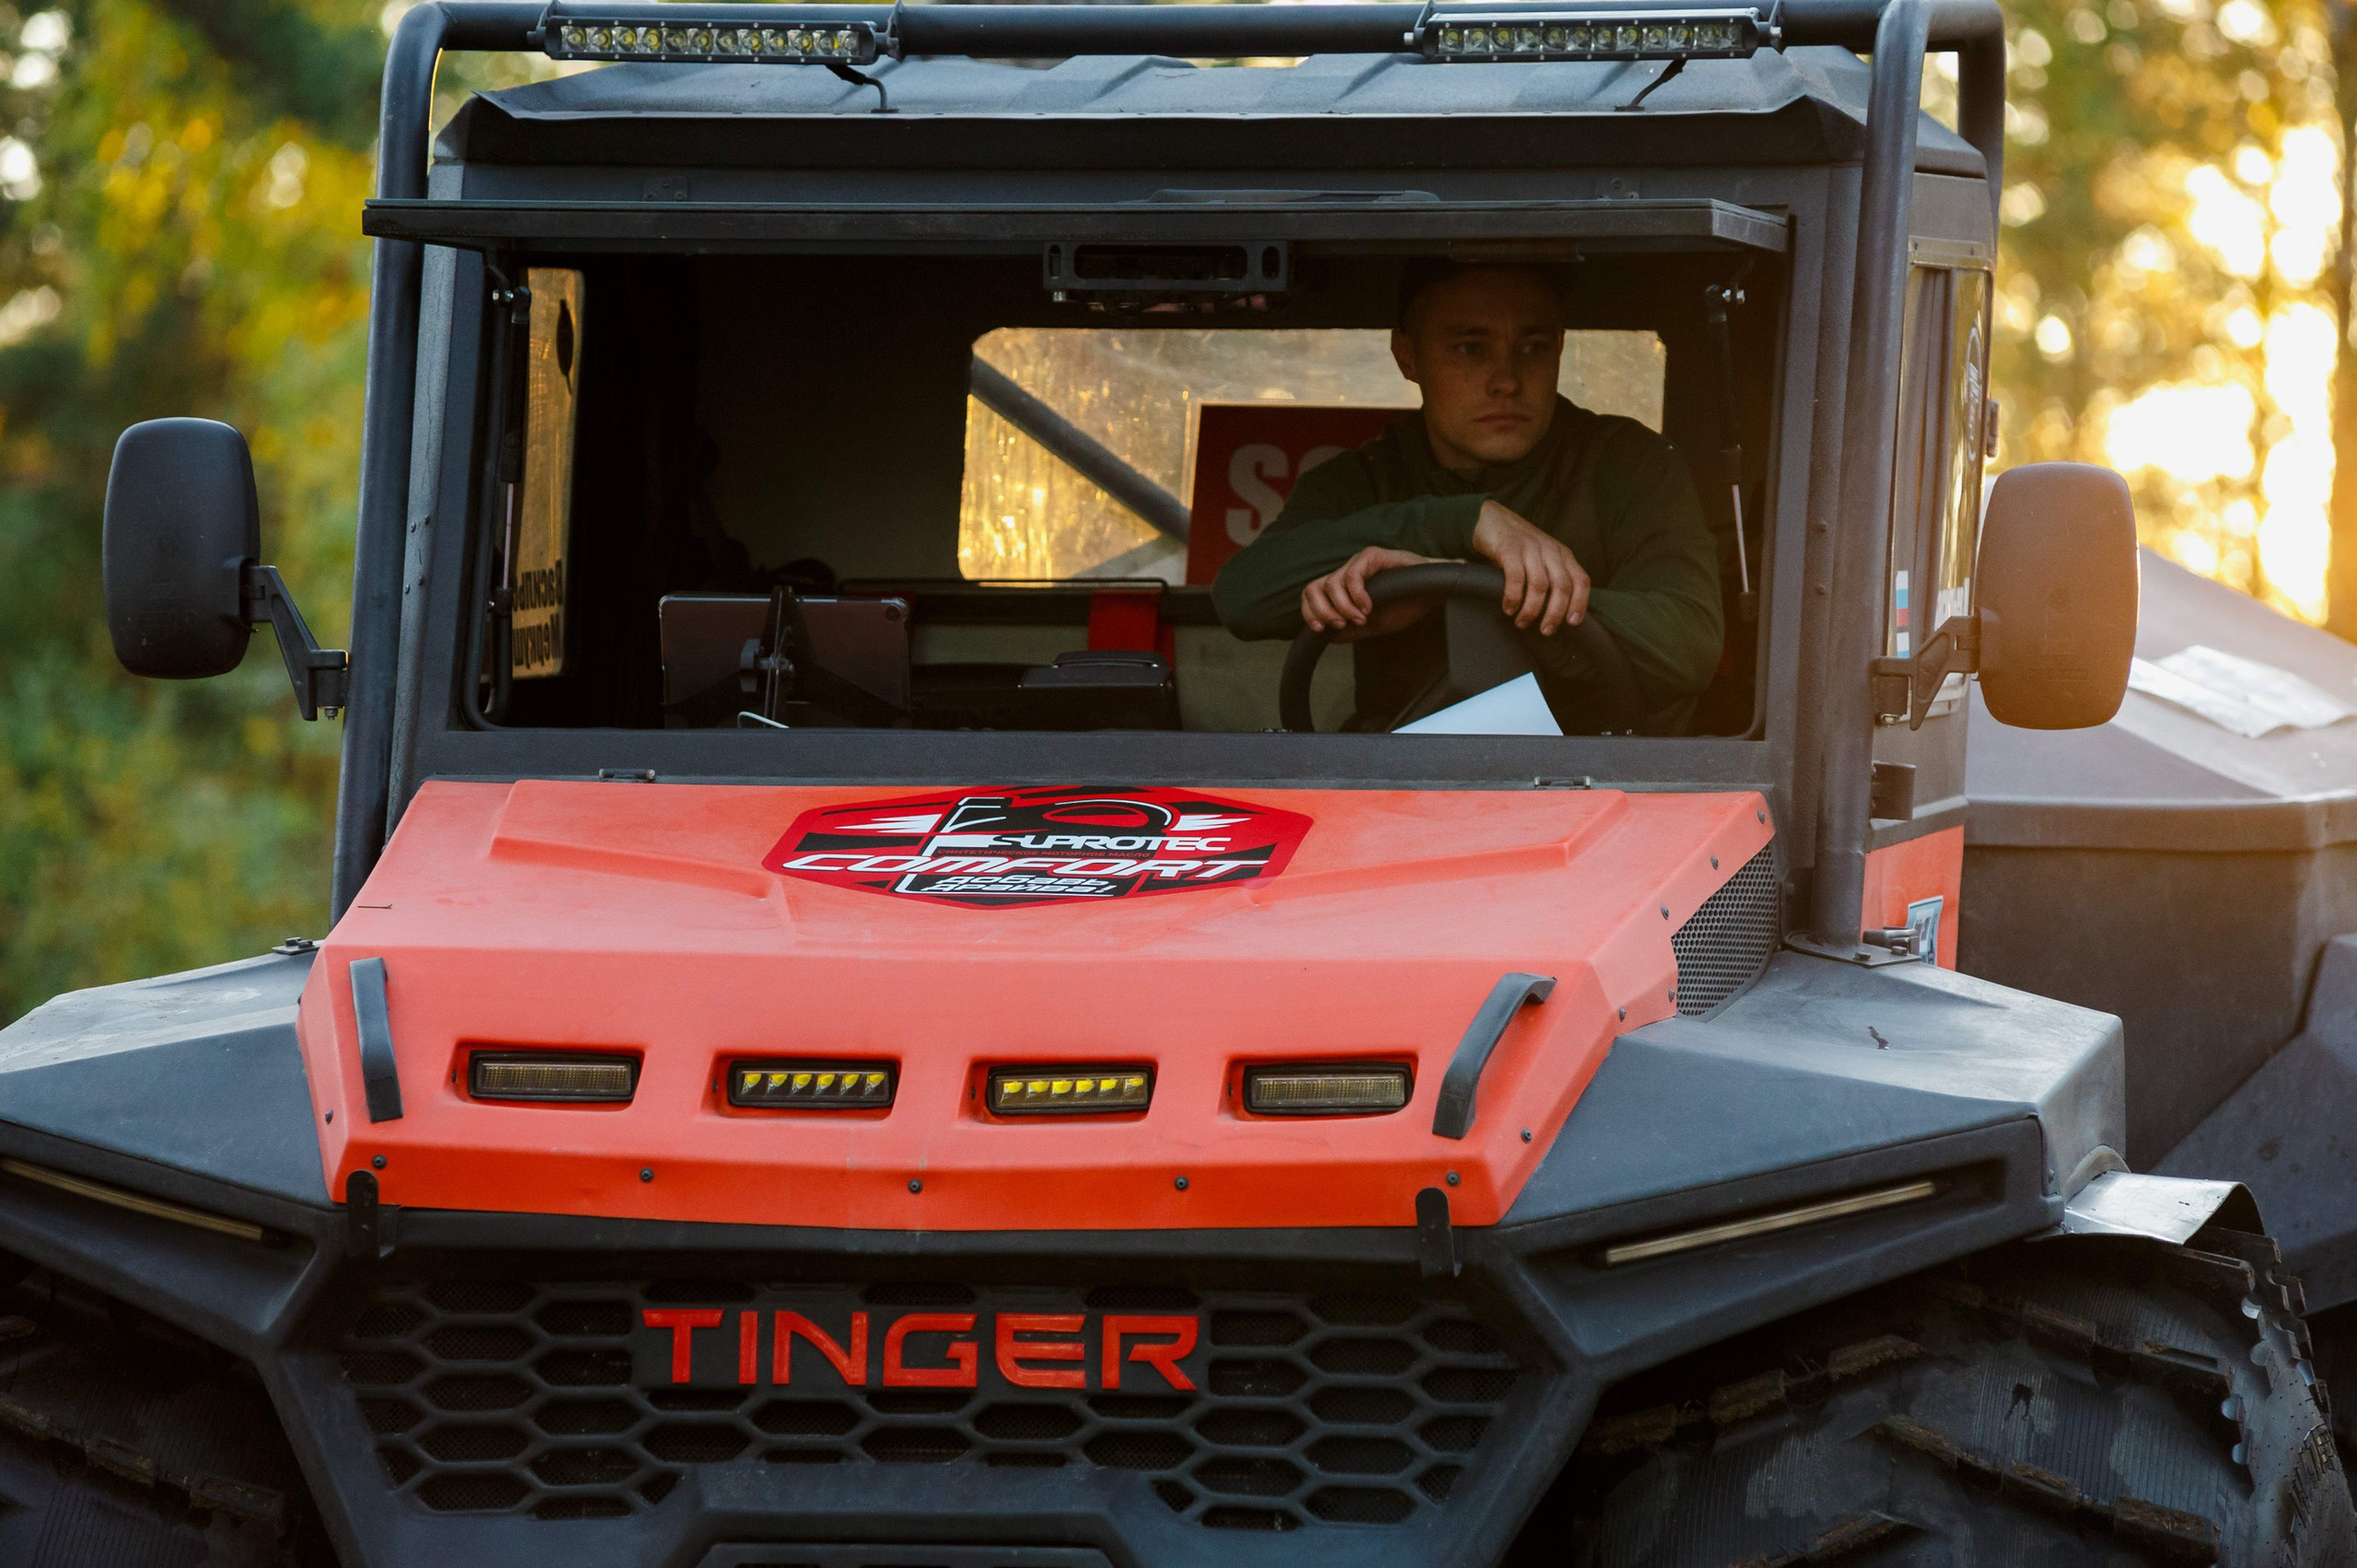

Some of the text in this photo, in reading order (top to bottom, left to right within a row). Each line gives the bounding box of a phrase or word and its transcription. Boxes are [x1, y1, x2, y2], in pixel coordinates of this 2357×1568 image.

[995, 834, 1231, 851] SUPROTEC
[936, 849, 1038, 857] СИНТЕТИЧЕСКОЕ
[783, 854, 1270, 877] COMFORT
[642, 1308, 1198, 1390] TINGER
